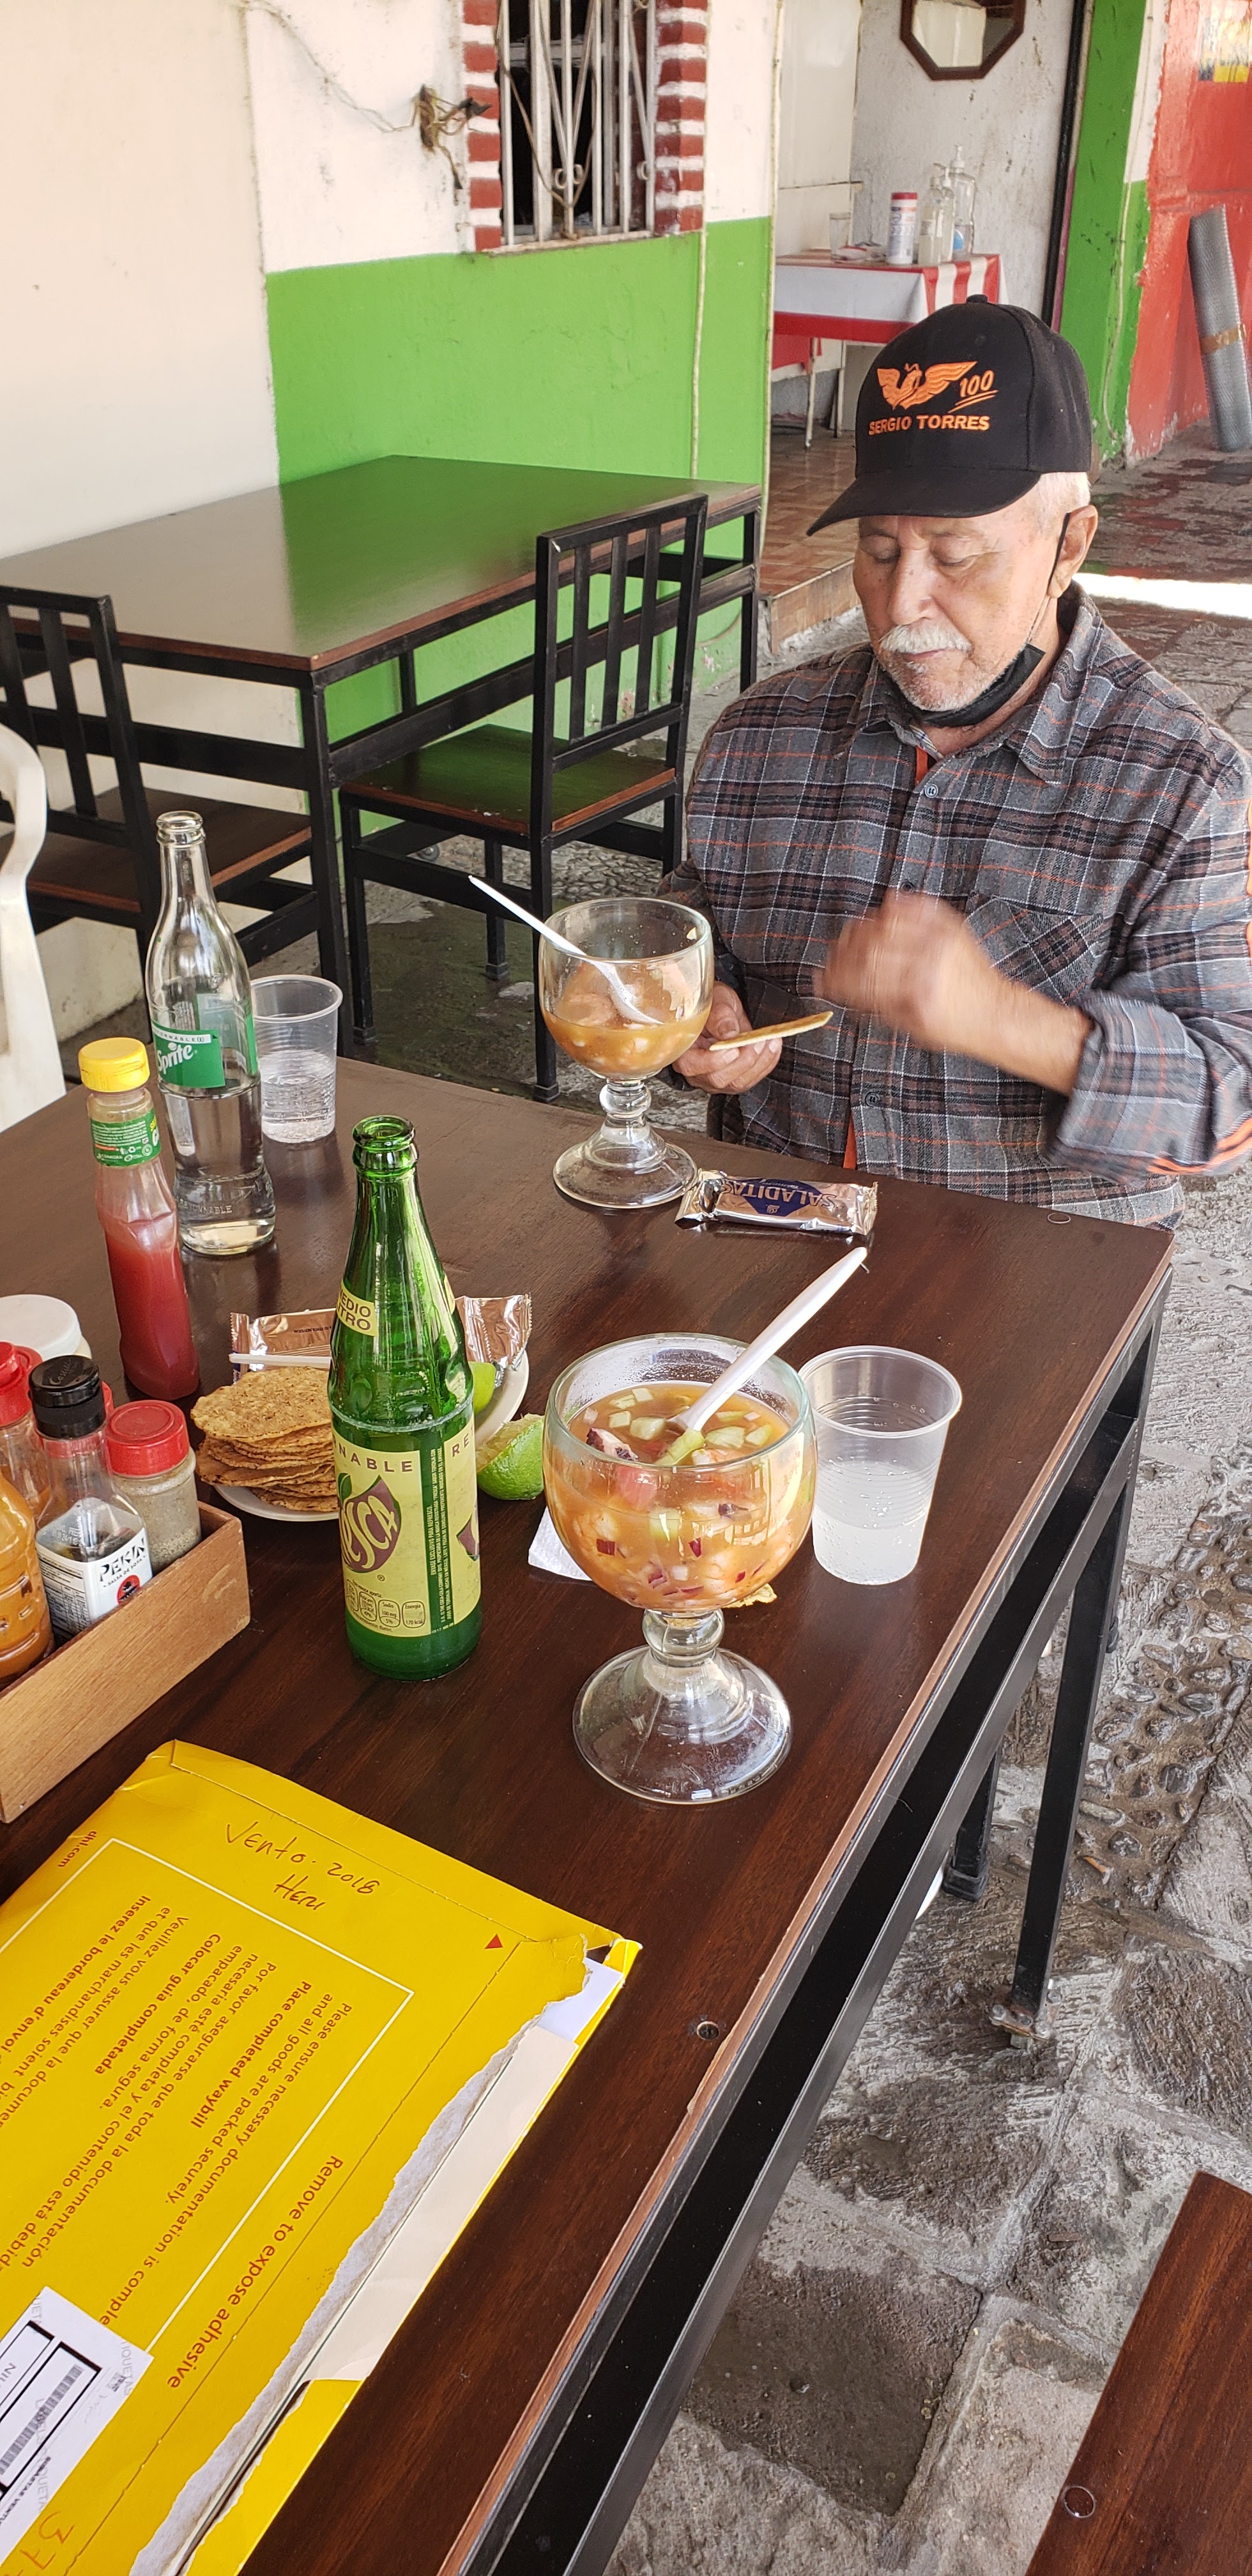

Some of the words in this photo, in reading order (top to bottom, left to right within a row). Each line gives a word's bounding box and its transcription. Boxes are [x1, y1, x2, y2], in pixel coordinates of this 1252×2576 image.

[959, 370, 995, 397] 100
[868, 416, 913, 436] SERGIO
[915, 414, 990, 431] TORRES
[156, 1042, 194, 1075] Sprite
[337, 1302, 371, 1331] ITRO
[341, 1495, 398, 1570] ESCA
[99, 1536, 145, 1582] PEKIN
[57, 1830, 97, 1867] dhl.com
[327, 1862, 380, 1894] 2018
[109, 1895, 151, 1933] Inserez
[135, 1920, 158, 1941] que
[156, 1907, 171, 1919] et
[98, 1934, 115, 1945] le
[120, 1942, 141, 1959] les
[143, 1917, 189, 1958] Veuillez
[181, 1934, 221, 1975] Colocar
[43, 1946, 103, 2004] bordereau
[119, 1960, 146, 1986] vous
[156, 1974, 181, 2002] guia
[186, 1945, 242, 2003] empacado,
[210, 1954, 259, 2005] necesaria
[255, 1962, 277, 1982] Por
[49, 1959, 122, 2037] marchandises
[82, 1987, 121, 2030] assurer
[228, 1984, 259, 2015] favor
[281, 1981, 312, 2011] Place
[311, 1994, 333, 2018] and
[172, 2007, 189, 2023] de
[188, 2008, 213, 2033] esté
[297, 2018, 314, 2035] all
[317, 2003, 353, 2039] Please
[13, 2037, 51, 2076] soient
[58, 2031, 82, 2054] que
[94, 2004, 158, 2074] completada
[139, 2026, 176, 2062] forma
[172, 2016, 229, 2081] asegurarse
[229, 2013, 283, 2078] completed
[267, 2034, 300, 2074] goods
[45, 2056, 63, 2068] la
[139, 2034, 190, 2092] completa
[284, 2041, 319, 2082] ensure
[0, 2082, 15, 2097] bi
[99, 2064, 142, 2109] segura.
[131, 2092, 143, 2103] y
[151, 2083, 174, 2108] que
[249, 2074, 270, 2096] are
[119, 2105, 133, 2120] el
[190, 2079, 233, 2128] waybill
[236, 2084, 287, 2147] necessary
[124, 2112, 155, 2142] toda
[211, 2097, 252, 2148] packed
[62, 2120, 120, 2187] contenido
[111, 2145, 129, 2158] la
[165, 2147, 214, 2204] securely.
[288, 2155, 344, 2220] Remove
[21, 2160, 113, 2267] documentación
[35, 2190, 63, 2220] está
[154, 2149, 238, 2253] documentation
[0, 2222, 36, 2271] debid
[273, 2223, 294, 2241] to
[143, 2255, 160, 2268] is
[227, 2245, 276, 2305] expose
[167, 2308, 230, 2388] adhesive
